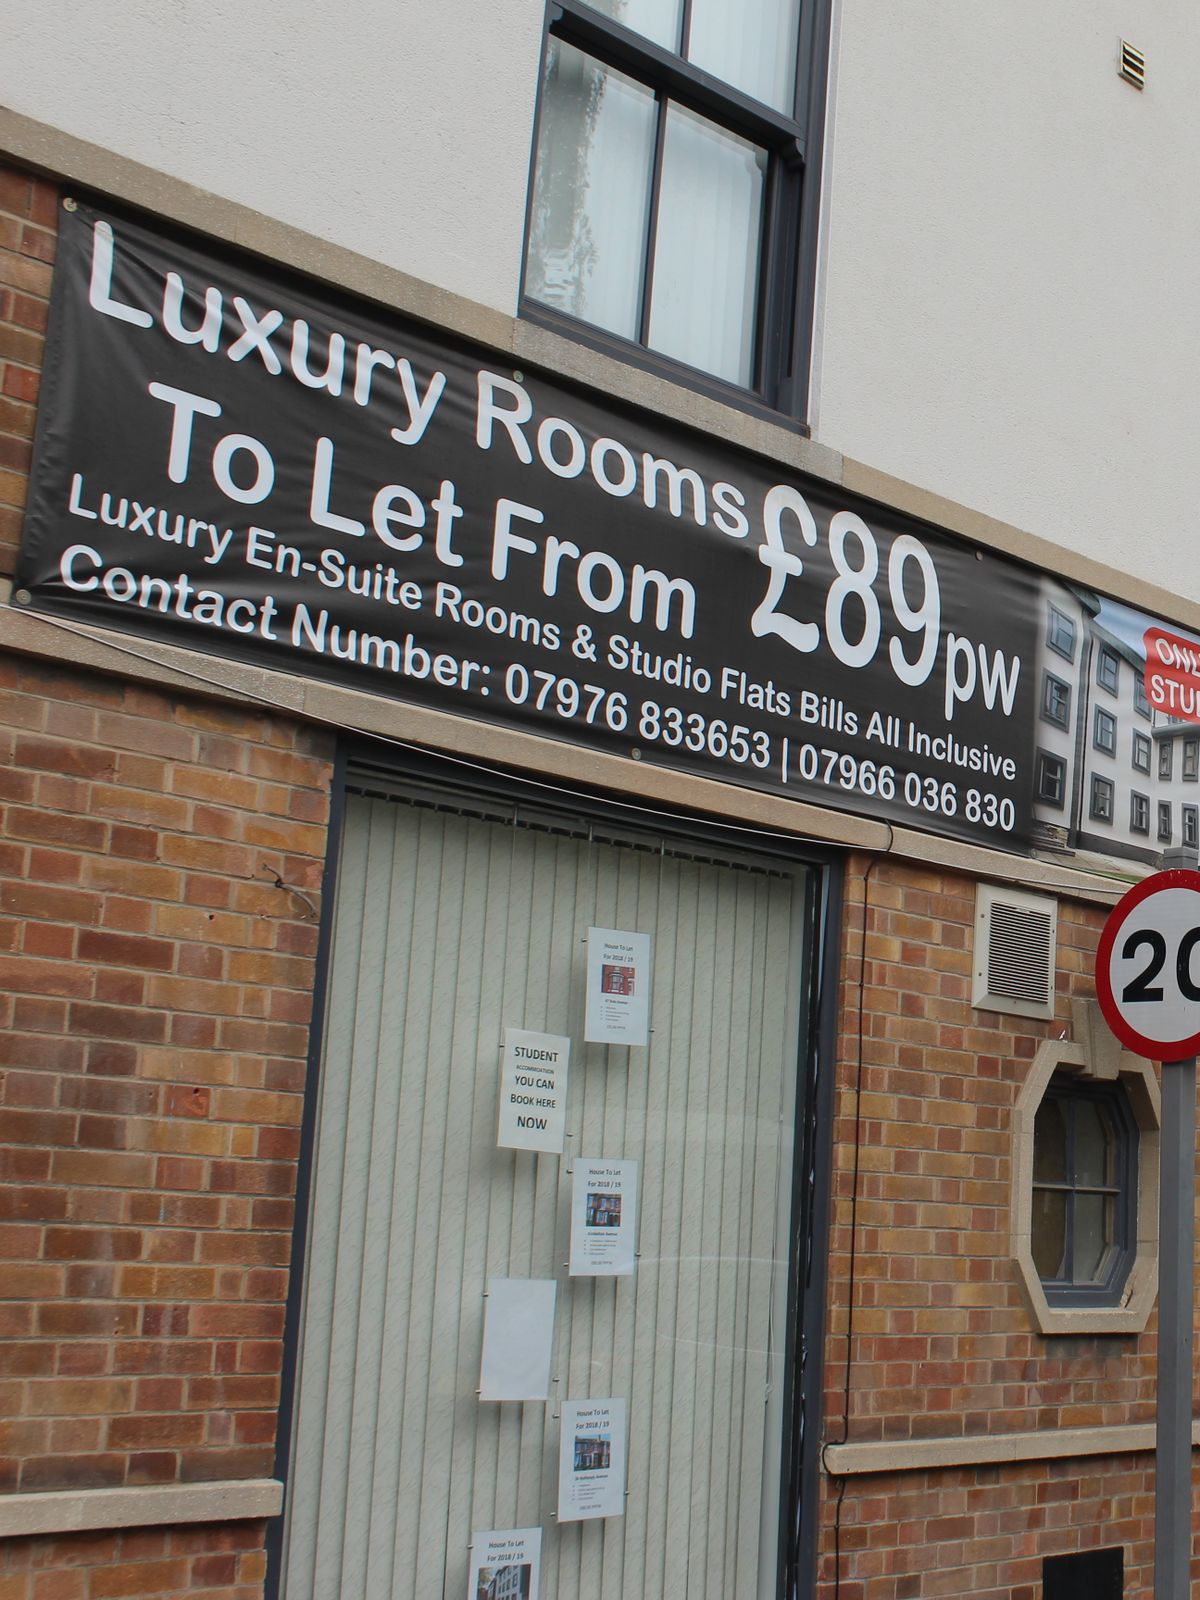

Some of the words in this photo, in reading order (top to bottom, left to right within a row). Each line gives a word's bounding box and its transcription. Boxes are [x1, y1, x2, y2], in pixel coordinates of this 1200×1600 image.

[88, 220, 447, 446] Luxury
[476, 370, 750, 539] Rooms
[148, 381, 275, 505] To
[309, 436, 464, 567] Let
[491, 498, 696, 639] From
[68, 473, 233, 565] Luxury
[246, 526, 423, 610] En-Suite
[435, 581, 560, 651] Rooms
[571, 624, 597, 663] &
[607, 634, 711, 694] Studio
[720, 667, 791, 717] Flats
[800, 690, 858, 736] Bills
[865, 711, 900, 748] All
[908, 722, 1016, 781] Inclusive
[59, 544, 278, 641] Contact
[291, 603, 491, 696] Number:
[505, 663, 628, 732] 07976
[638, 700, 770, 769] 833653
[799, 743, 895, 801] 07966
[904, 772, 957, 817] 036
[965, 788, 1015, 832] 830
[514, 1046, 559, 1062] STUDENT
[515, 1075, 534, 1087] YOU
[536, 1078, 555, 1090] CAN
[510, 1093, 535, 1106] BOOK
[535, 1097, 556, 1109] HERE
[517, 1115, 548, 1130] NOW
[593, 1408, 601, 1416] To
[488, 1541, 506, 1549] House
[515, 1539, 525, 1547] Let
